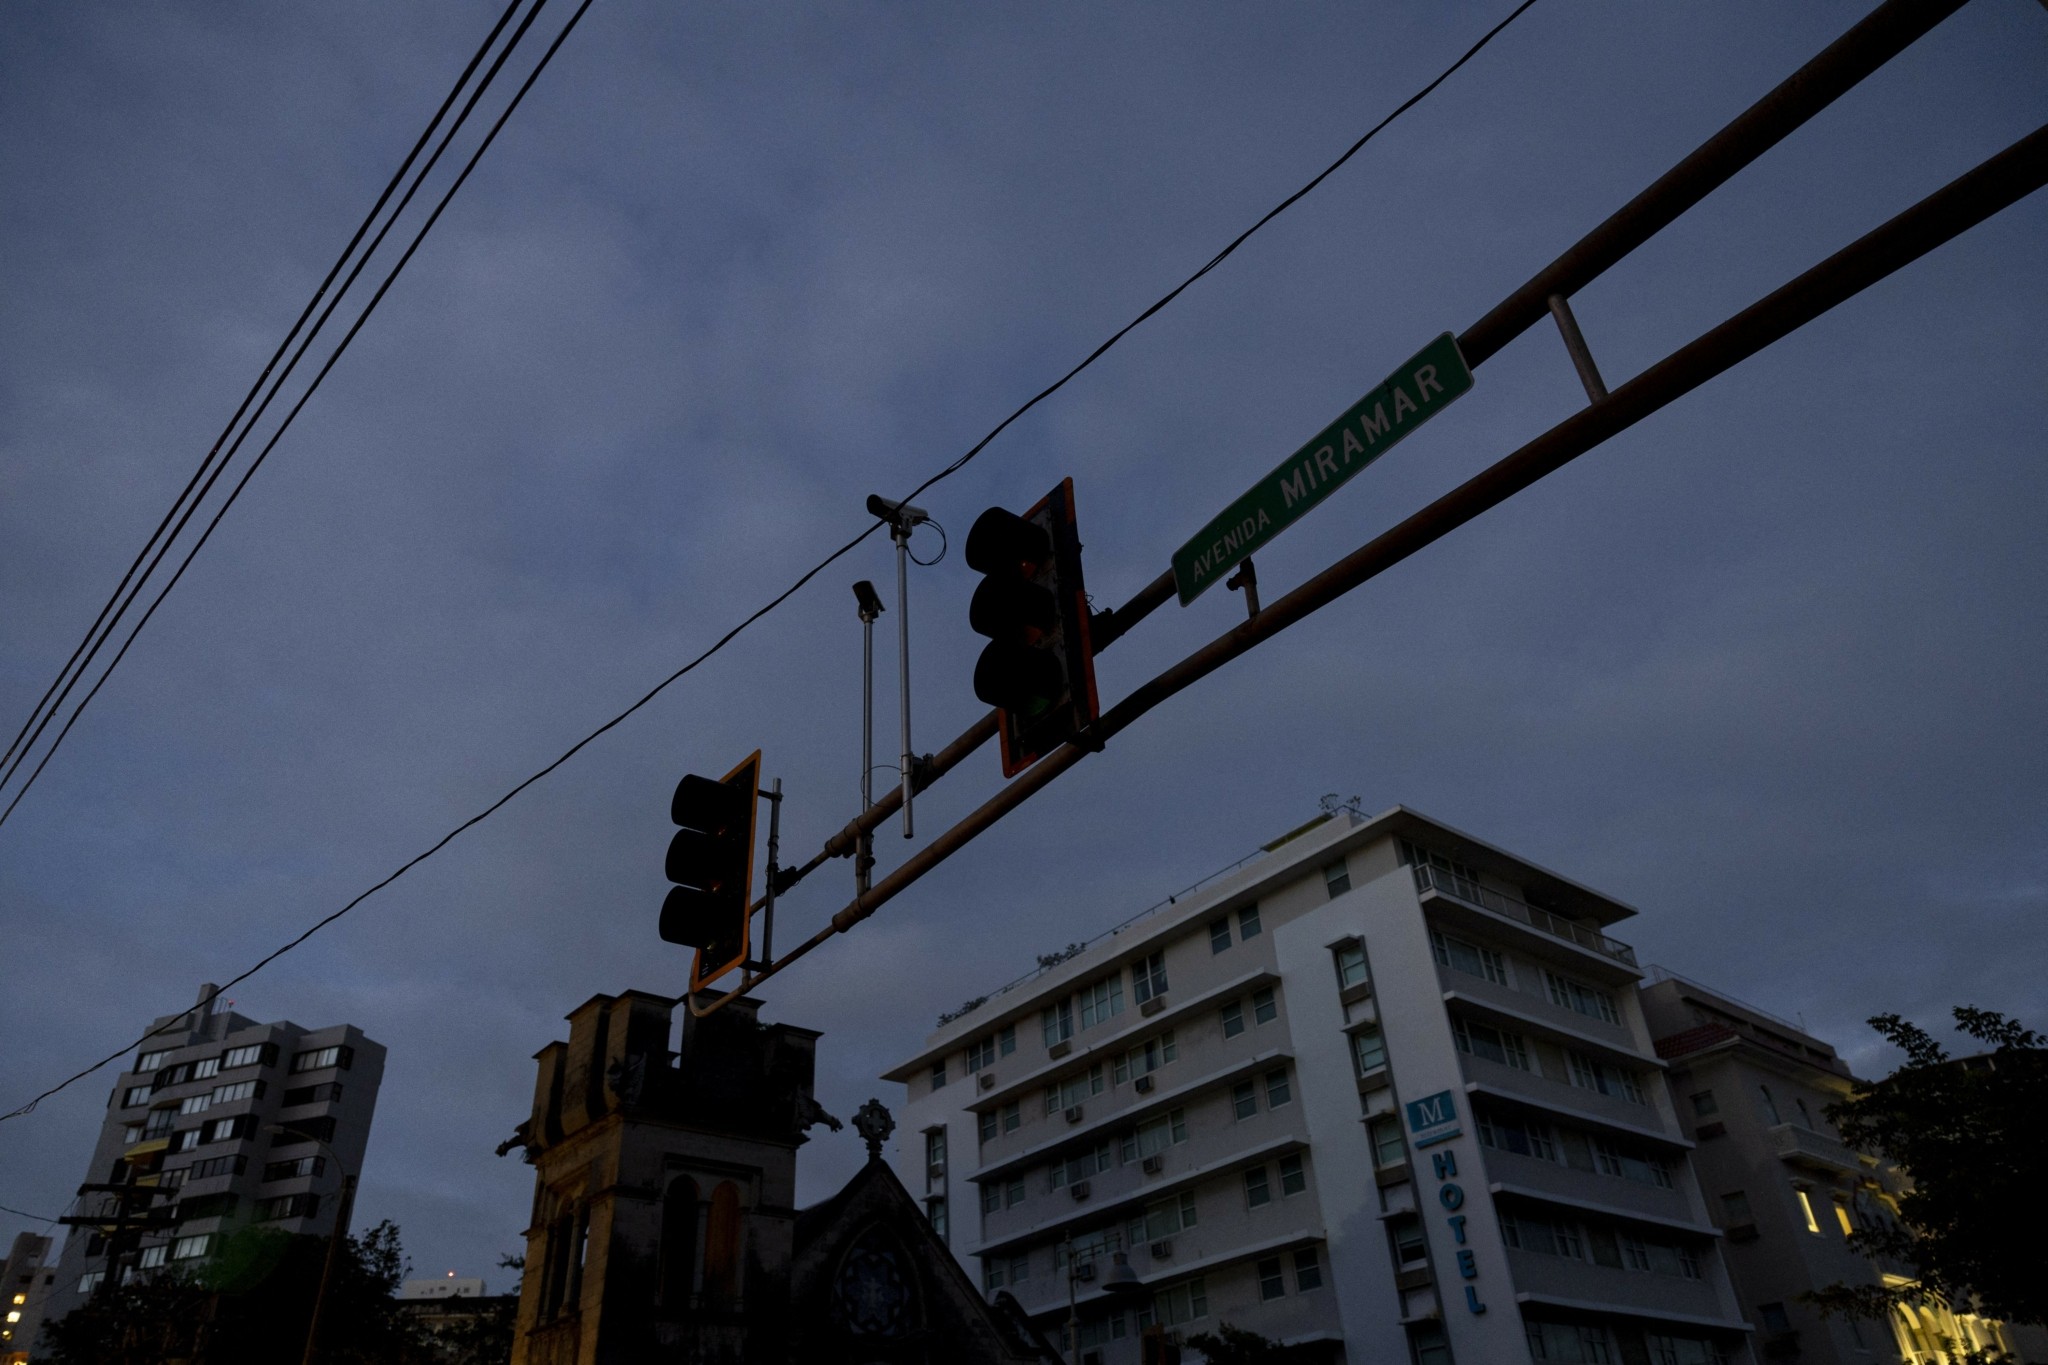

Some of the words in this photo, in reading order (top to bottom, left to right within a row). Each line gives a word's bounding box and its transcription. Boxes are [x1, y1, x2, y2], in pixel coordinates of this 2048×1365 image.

[1194, 508, 1271, 582] AVENIDA
[1280, 363, 1444, 508] MIRAMAR
[1417, 1097, 1445, 1126] M
[1432, 1151, 1486, 1314] HOTEL
